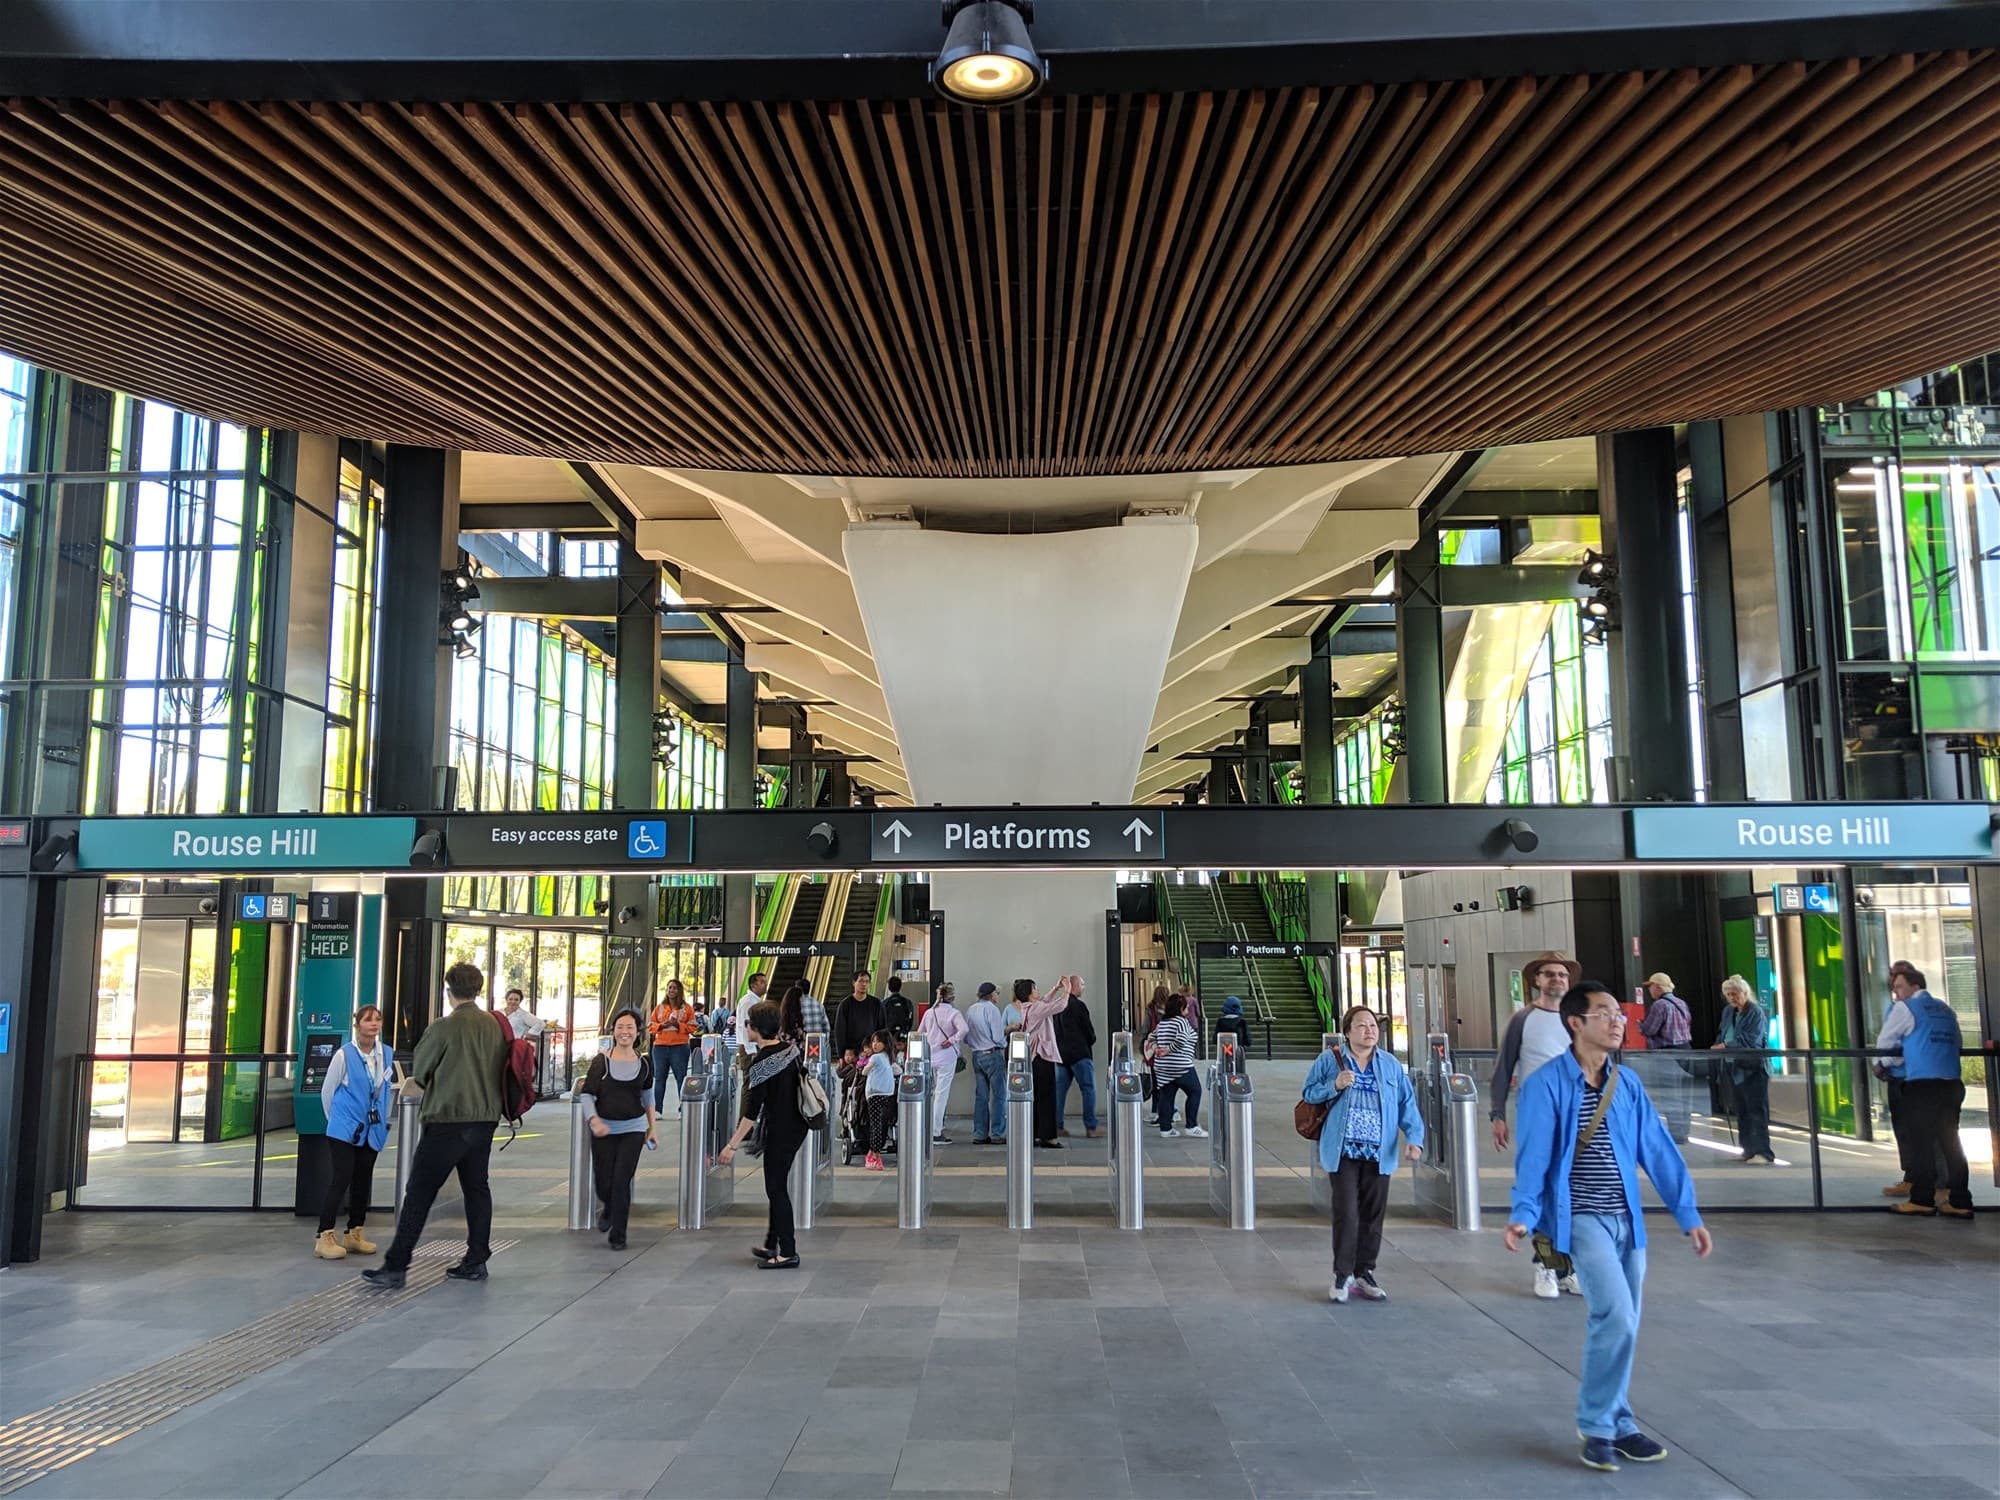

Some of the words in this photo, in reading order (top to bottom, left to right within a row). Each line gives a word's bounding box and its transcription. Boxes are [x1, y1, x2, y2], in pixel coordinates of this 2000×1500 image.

[491, 828, 526, 844] Easy
[529, 829, 581, 842] access
[584, 827, 618, 844] gate
[945, 822, 1091, 849] Platforms
[1737, 818, 1833, 845] Rouse
[1841, 817, 1890, 844] Hill
[173, 830, 262, 857] Rouse
[271, 829, 317, 856] Hill
[311, 933, 349, 942] Emergency
[311, 942, 349, 955] HELP
[760, 945, 800, 955] Platforms
[1246, 945, 1286, 954] Platforms
